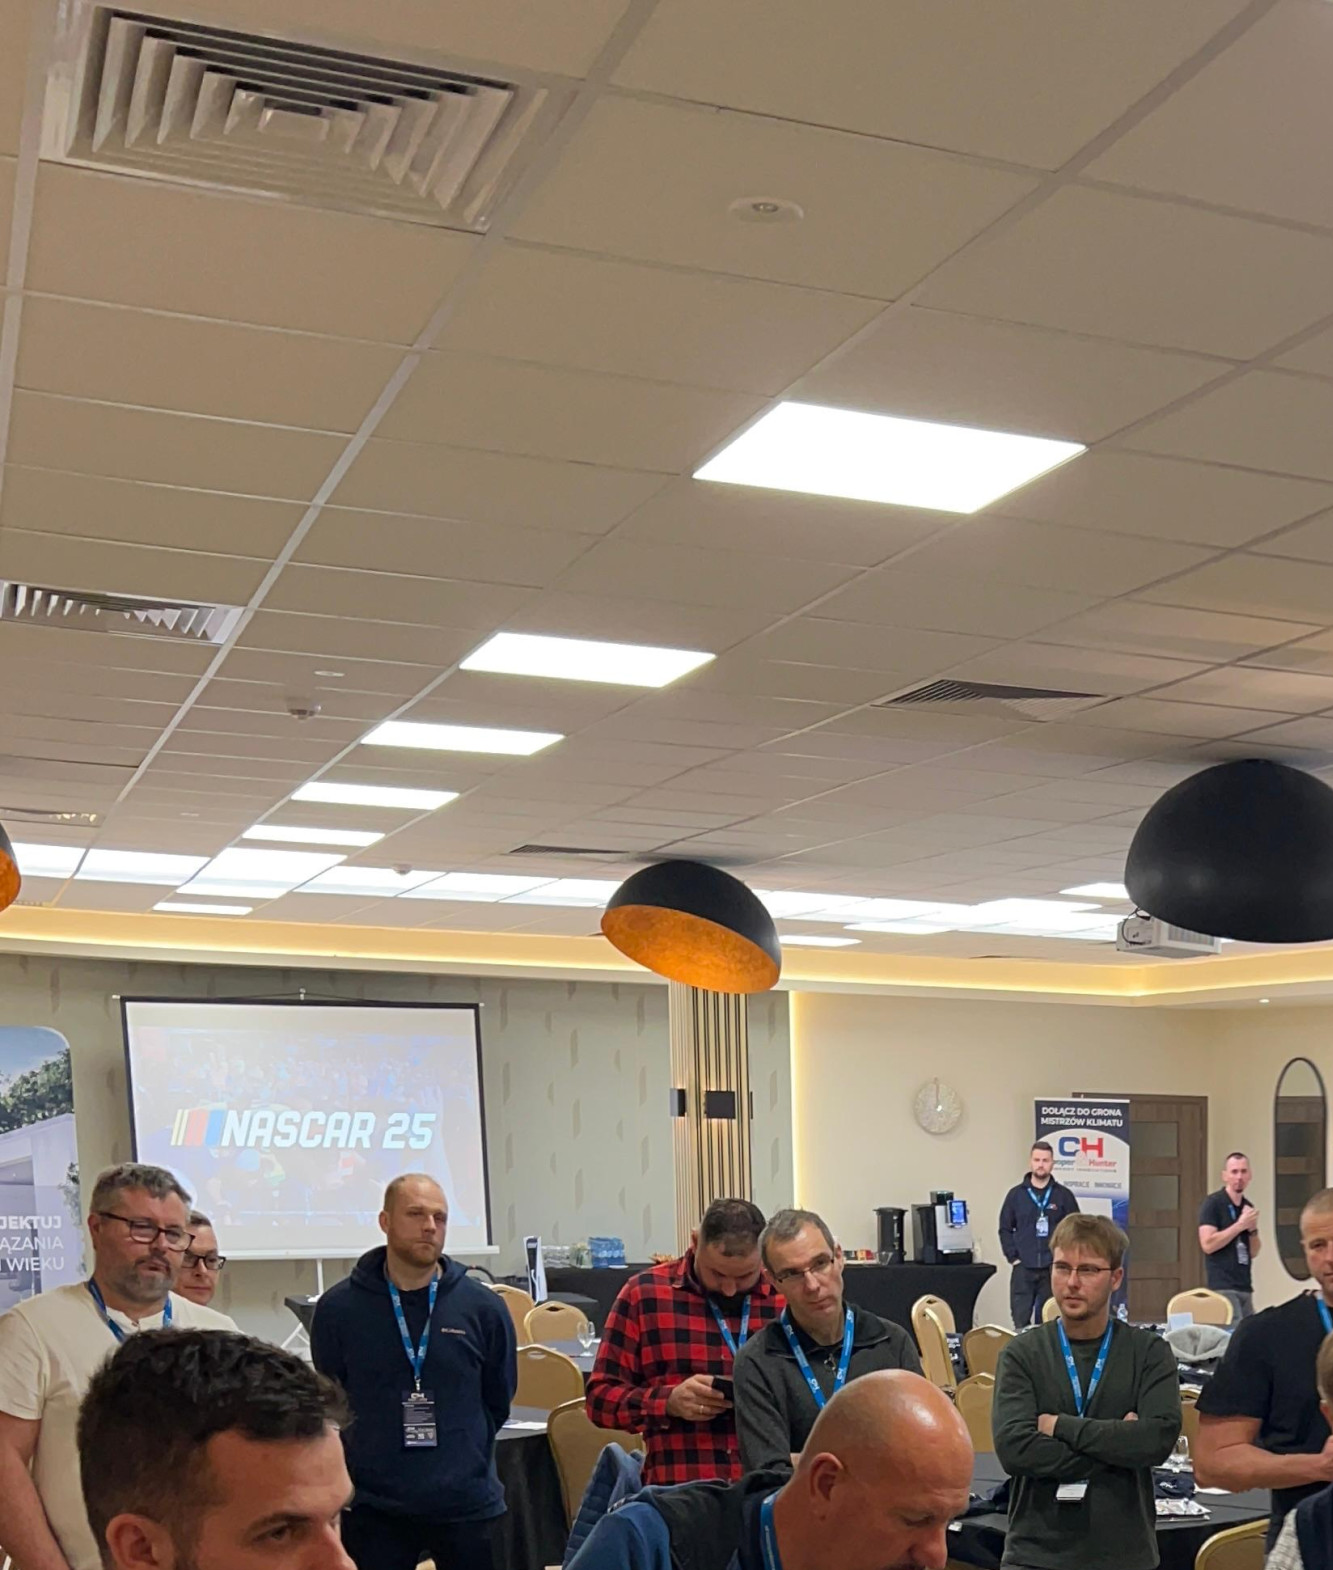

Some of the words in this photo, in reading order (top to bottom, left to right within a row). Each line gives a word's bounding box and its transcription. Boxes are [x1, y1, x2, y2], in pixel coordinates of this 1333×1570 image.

[1042, 1107, 1075, 1116] DOŁĄCZ
[1091, 1108, 1122, 1116] GRONA
[1041, 1117, 1085, 1126] MISTRZÓW
[1086, 1118, 1123, 1127] KLIMATU
[221, 1110, 376, 1148] NASCAR
[382, 1113, 436, 1149] 25
[1059, 1136, 1103, 1158] CH
[6, 1257, 65, 1271] WIEKU
